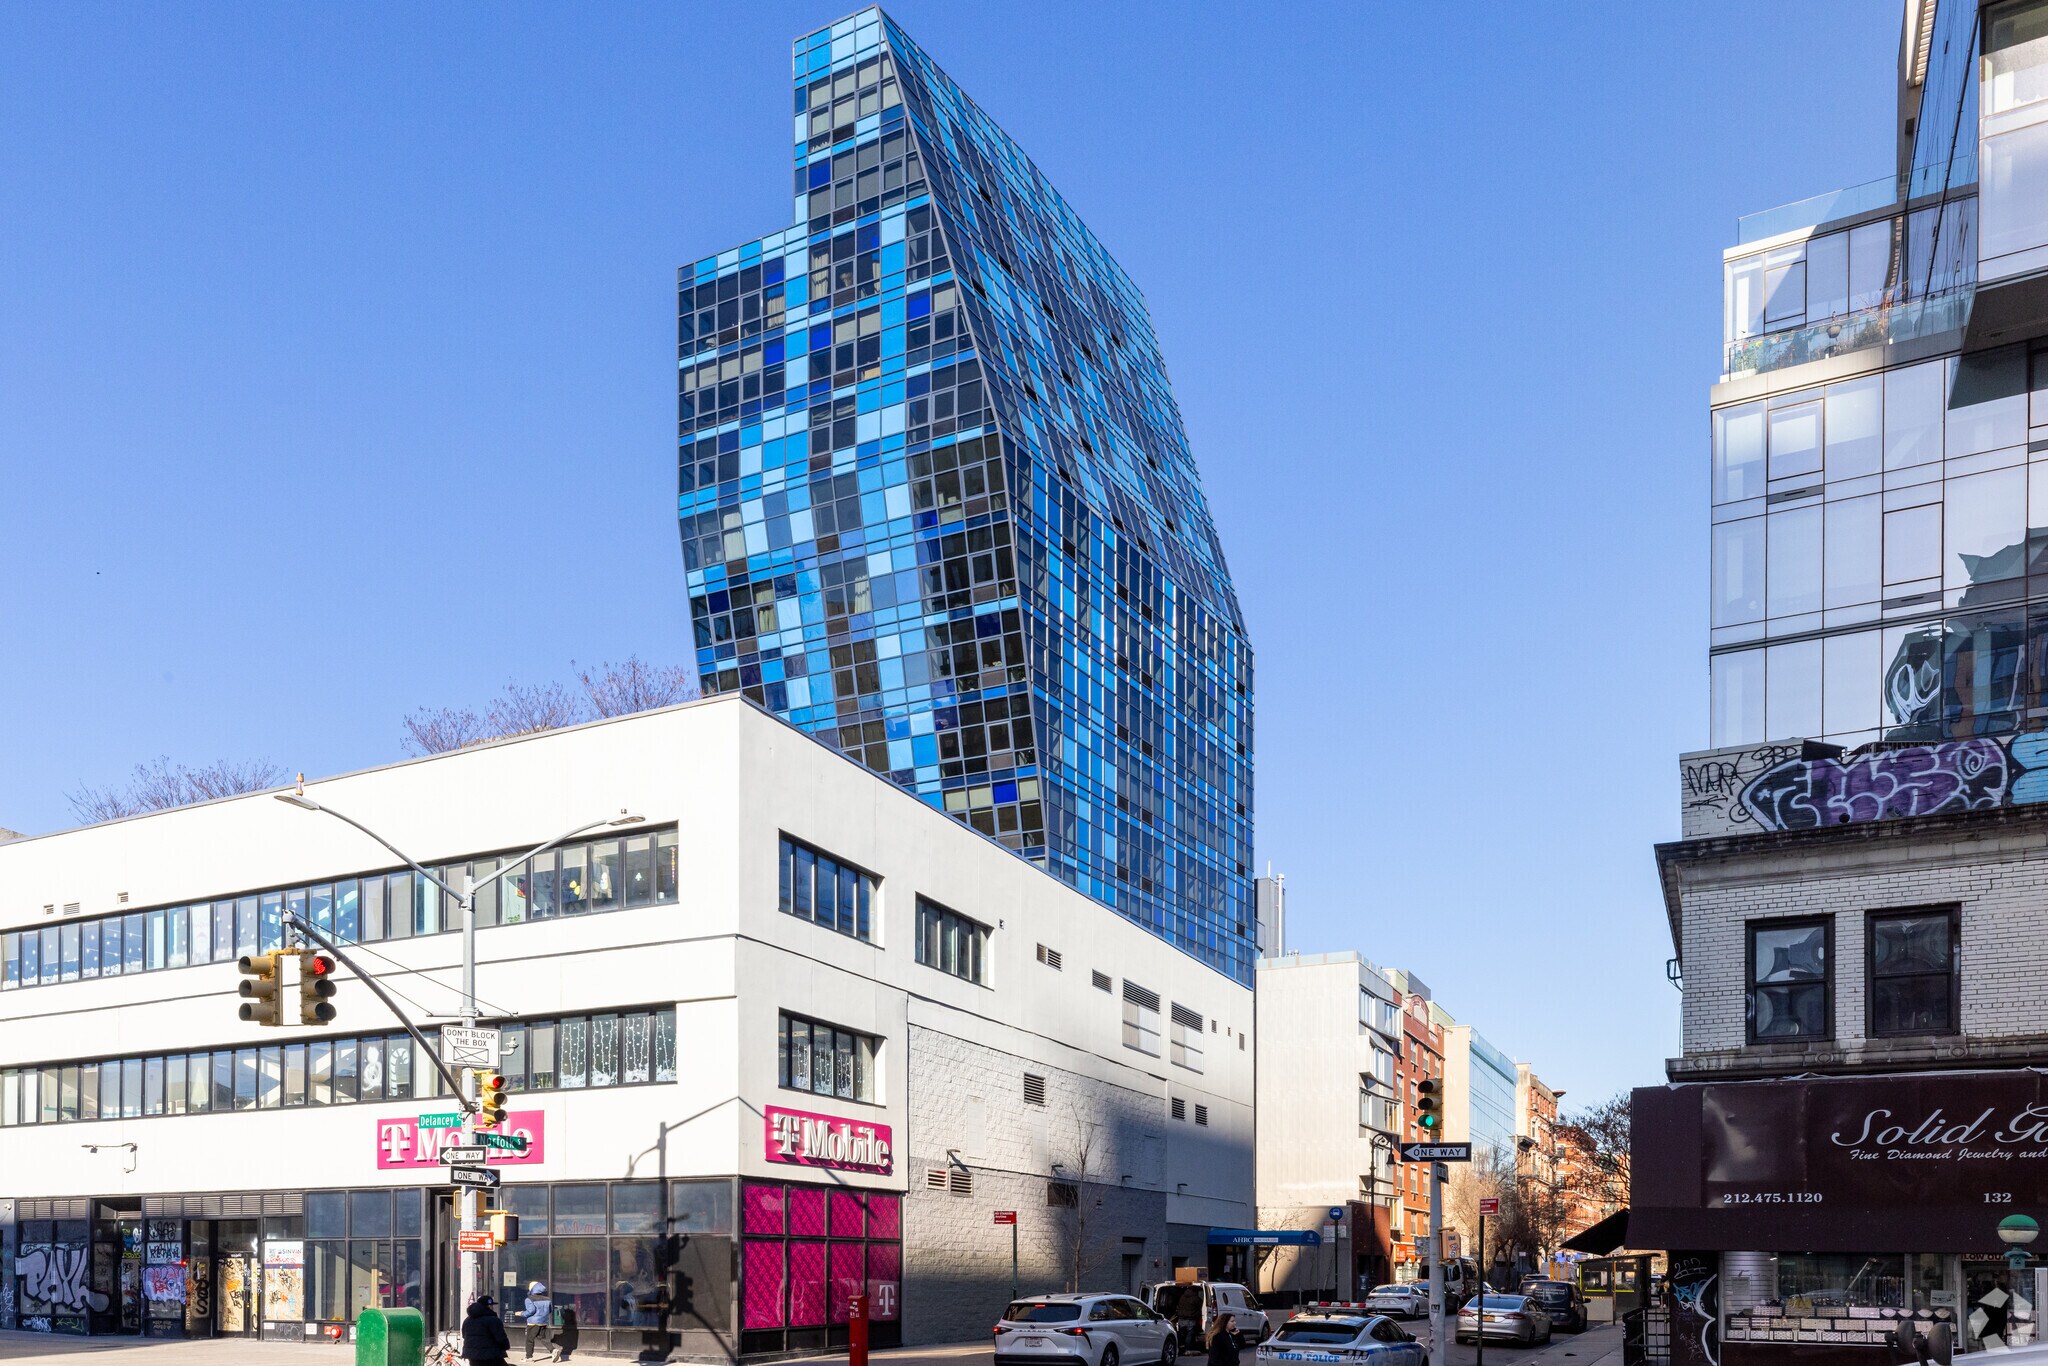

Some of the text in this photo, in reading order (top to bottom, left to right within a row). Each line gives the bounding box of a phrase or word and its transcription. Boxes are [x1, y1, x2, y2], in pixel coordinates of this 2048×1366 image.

[447, 1029, 496, 1040] DON'T BLOCK
[456, 1038, 470, 1046] THE
[420, 1115, 454, 1126] Delancey
[1831, 1107, 1995, 1146] Solid
[480, 1135, 515, 1148] Norfolk
[801, 1117, 889, 1167] Mobile
[446, 1152, 480, 1160] ONE WAY
[1414, 1148, 1462, 1156] ONE WAY
[1850, 1148, 2048, 1161] Fine Diamond Jewelry and
[457, 1172, 494, 1182] ONE WAY
[1723, 1192, 1823, 1204] 212.475.1120
[1983, 1192, 2012, 1203] 132
[1278, 1352, 1340, 1362] NYPD POLICE
